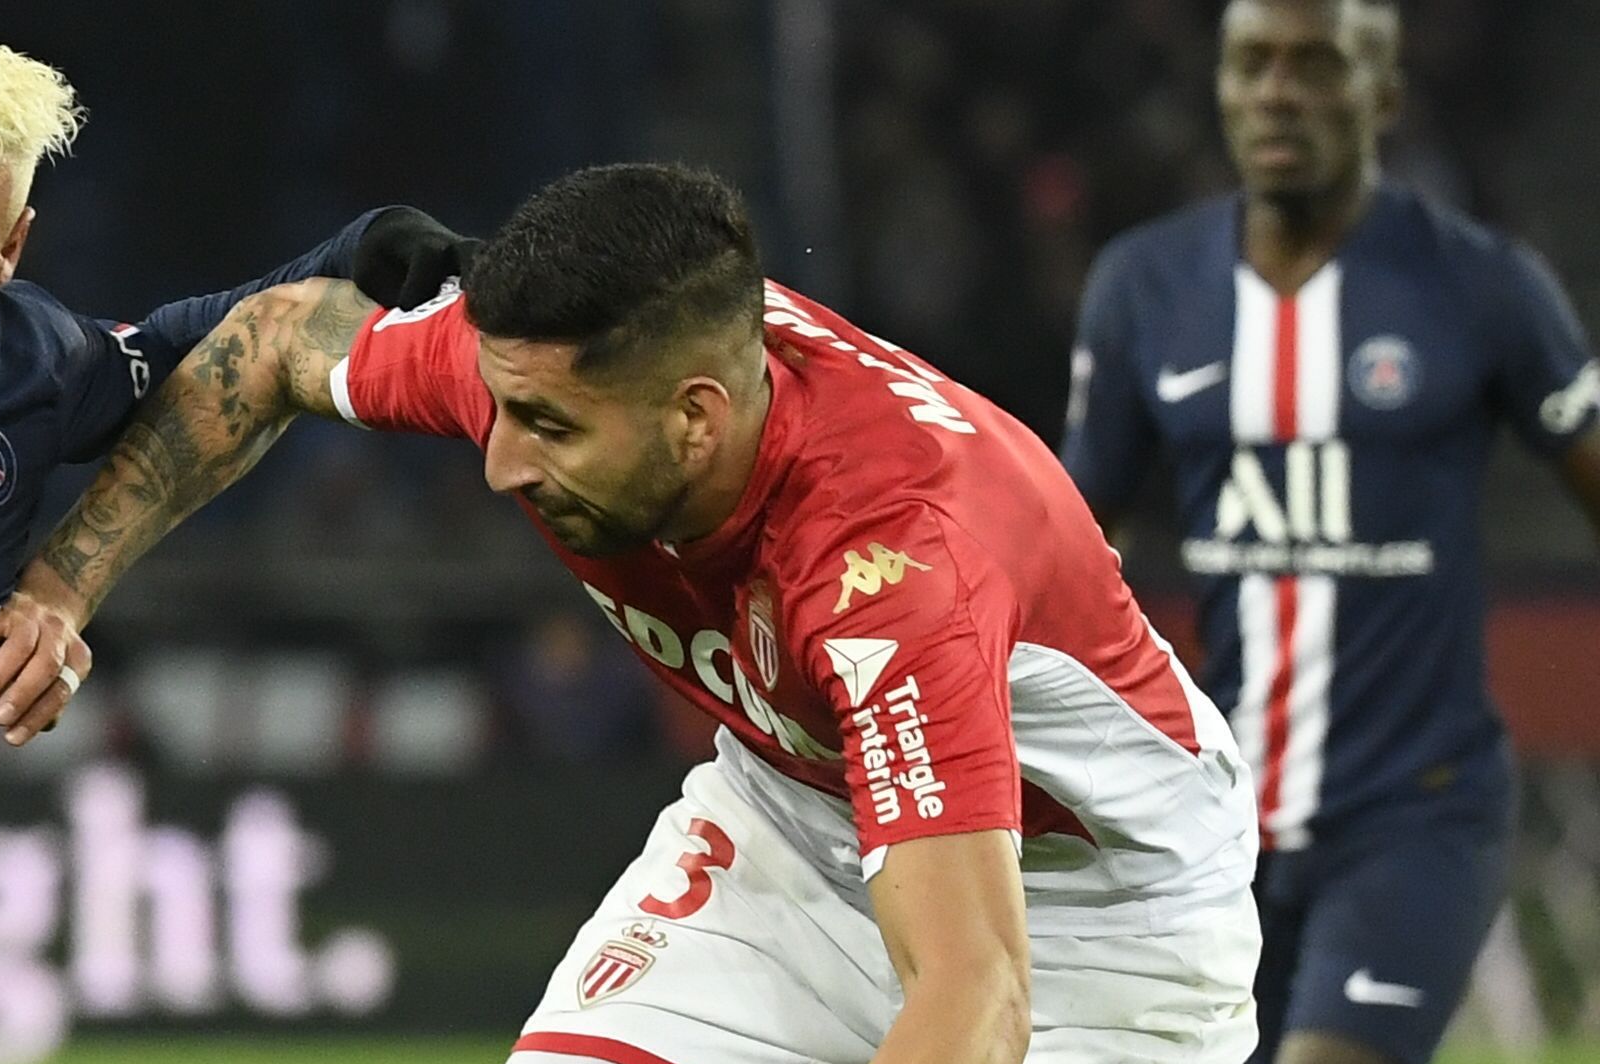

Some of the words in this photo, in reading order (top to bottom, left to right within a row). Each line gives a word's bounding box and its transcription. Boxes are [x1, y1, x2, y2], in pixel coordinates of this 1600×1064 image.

[852, 704, 902, 825] intérim
[884, 674, 947, 820] Triangle
[636, 817, 737, 920] 3
